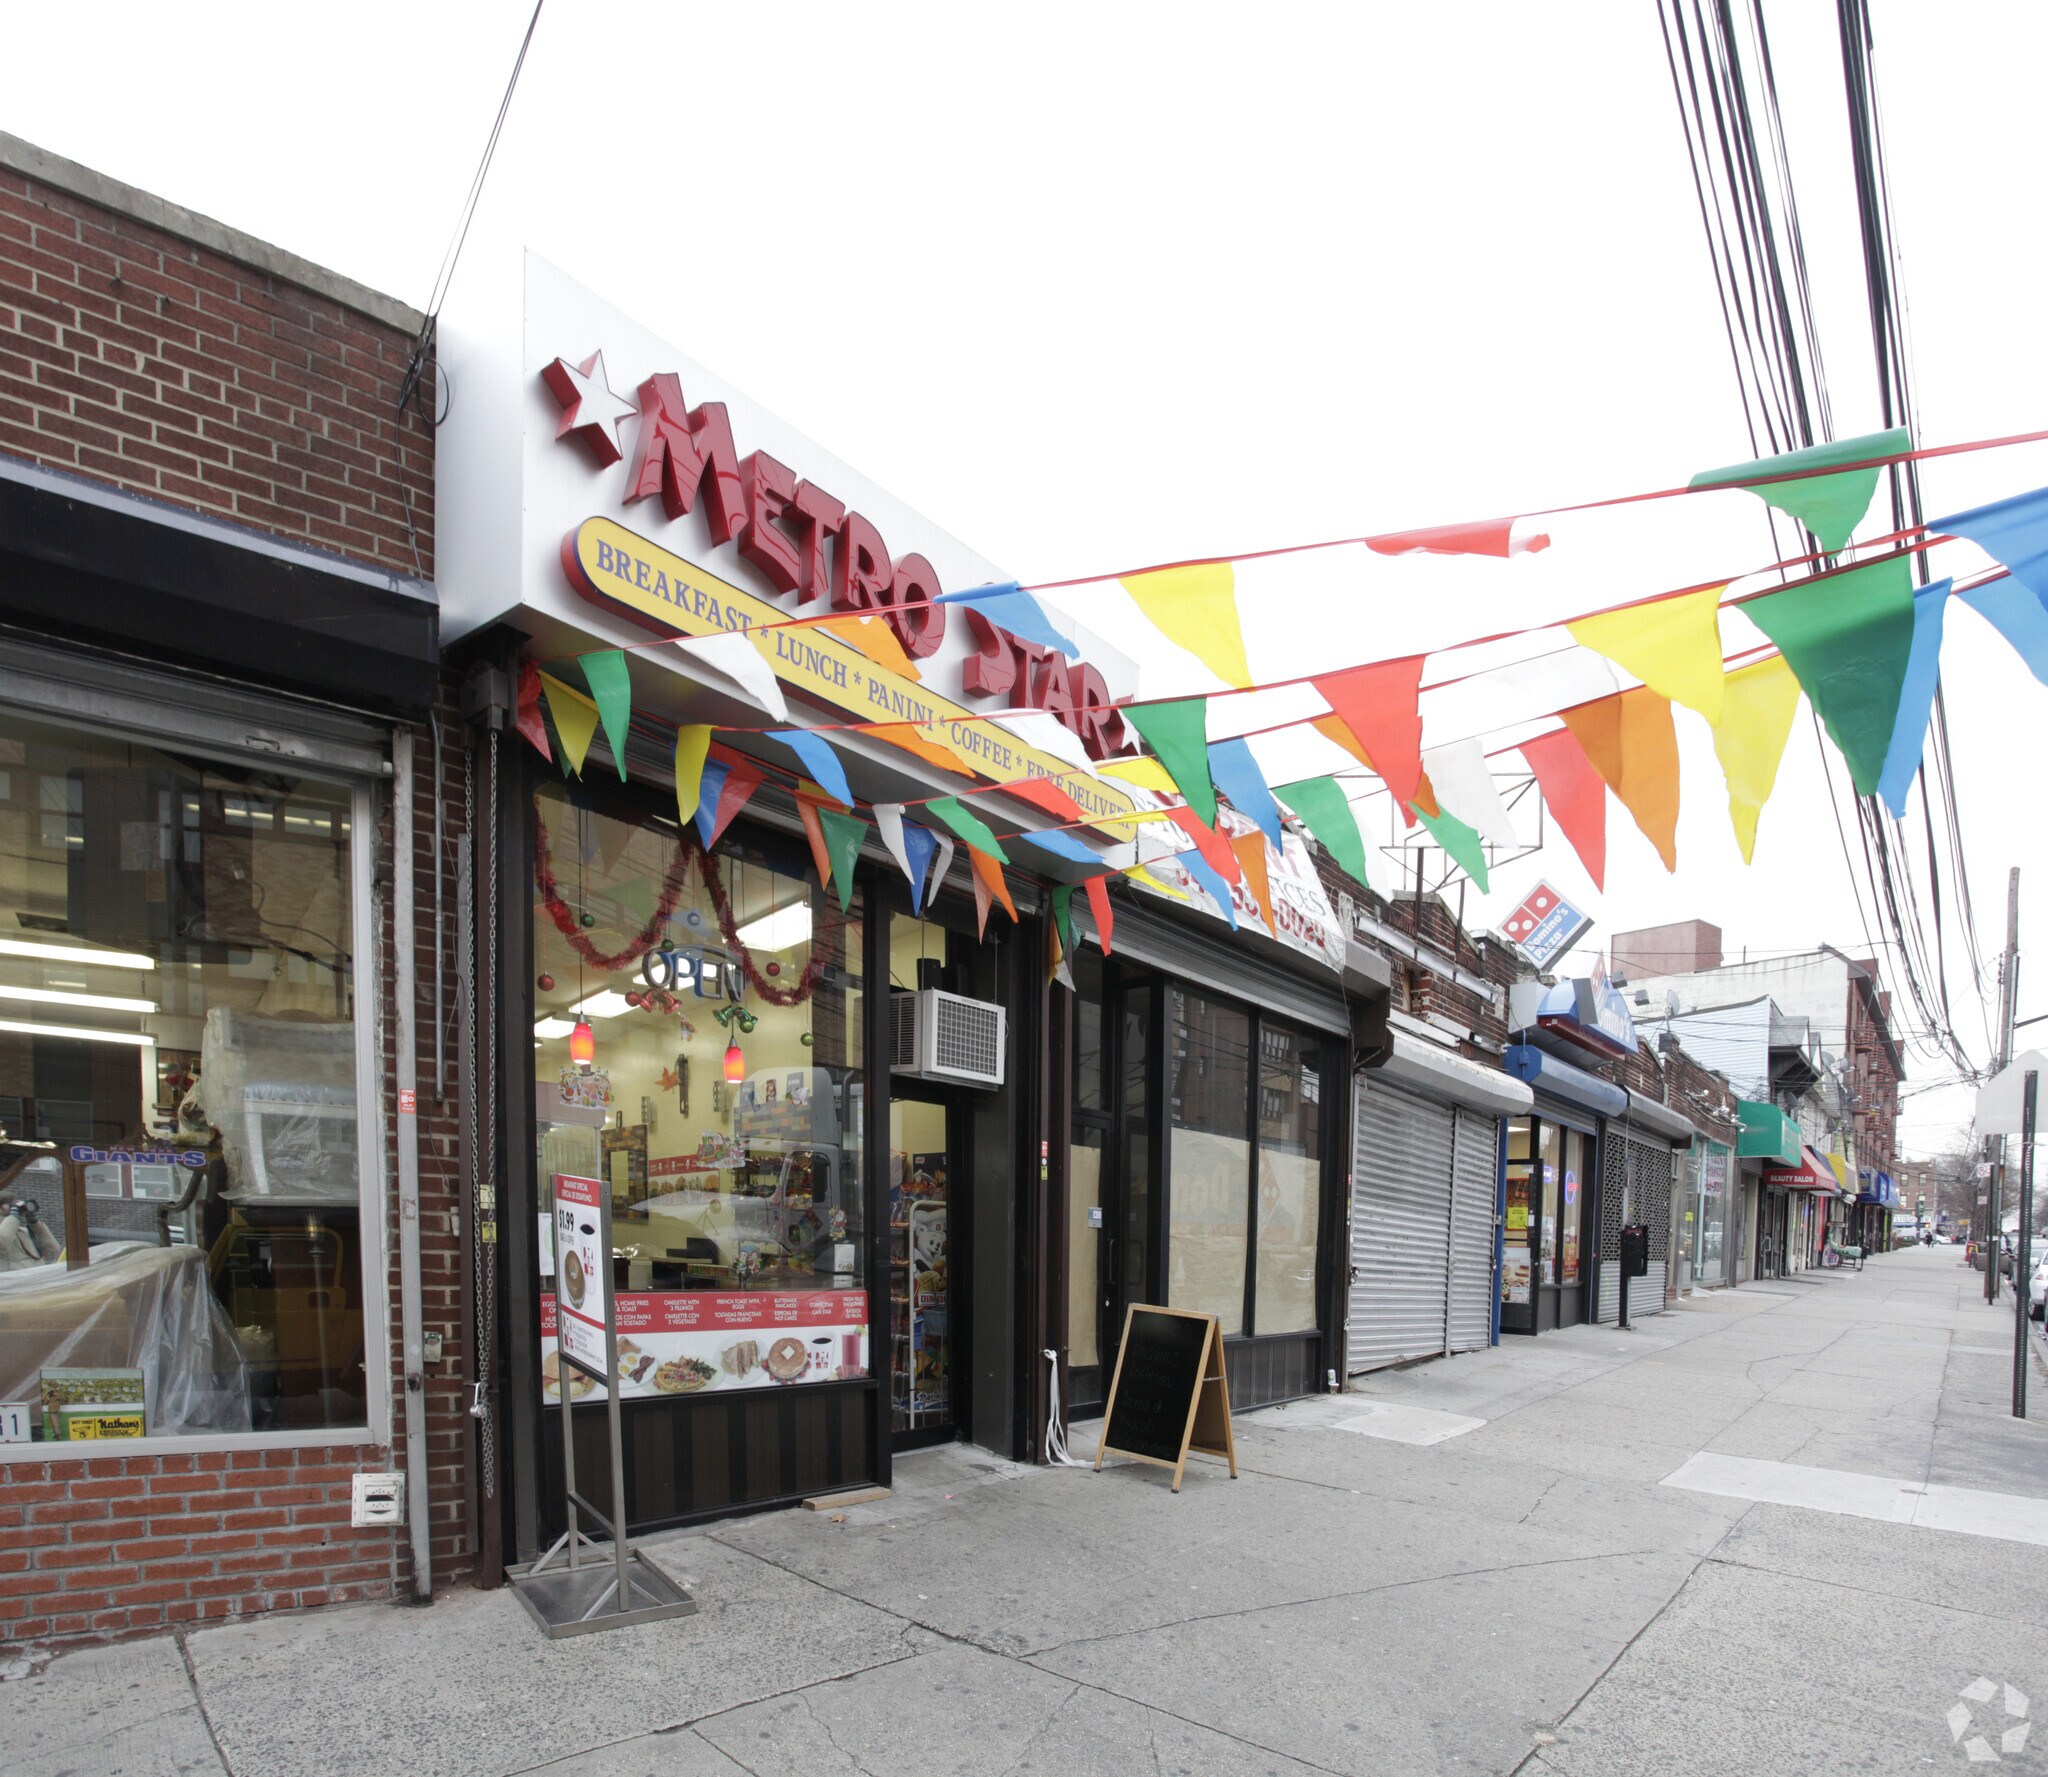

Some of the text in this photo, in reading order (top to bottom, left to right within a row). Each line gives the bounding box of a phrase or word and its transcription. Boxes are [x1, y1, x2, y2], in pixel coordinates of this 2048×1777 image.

[623, 373, 1111, 761] METRO STAR
[596, 538, 752, 640] BREAKFAST
[776, 631, 848, 690] LUNCH
[868, 677, 935, 733] PANINI
[951, 721, 1012, 770] COFFEE
[1524, 907, 1569, 952] Domino's
[1533, 929, 1563, 960] Pizza
[642, 946, 747, 1003] OPEN
[70, 1146, 206, 1167] GIANTS
[1770, 1175, 1814, 1184] BEAUTY SALON
[559, 1207, 574, 1231] $1.99
